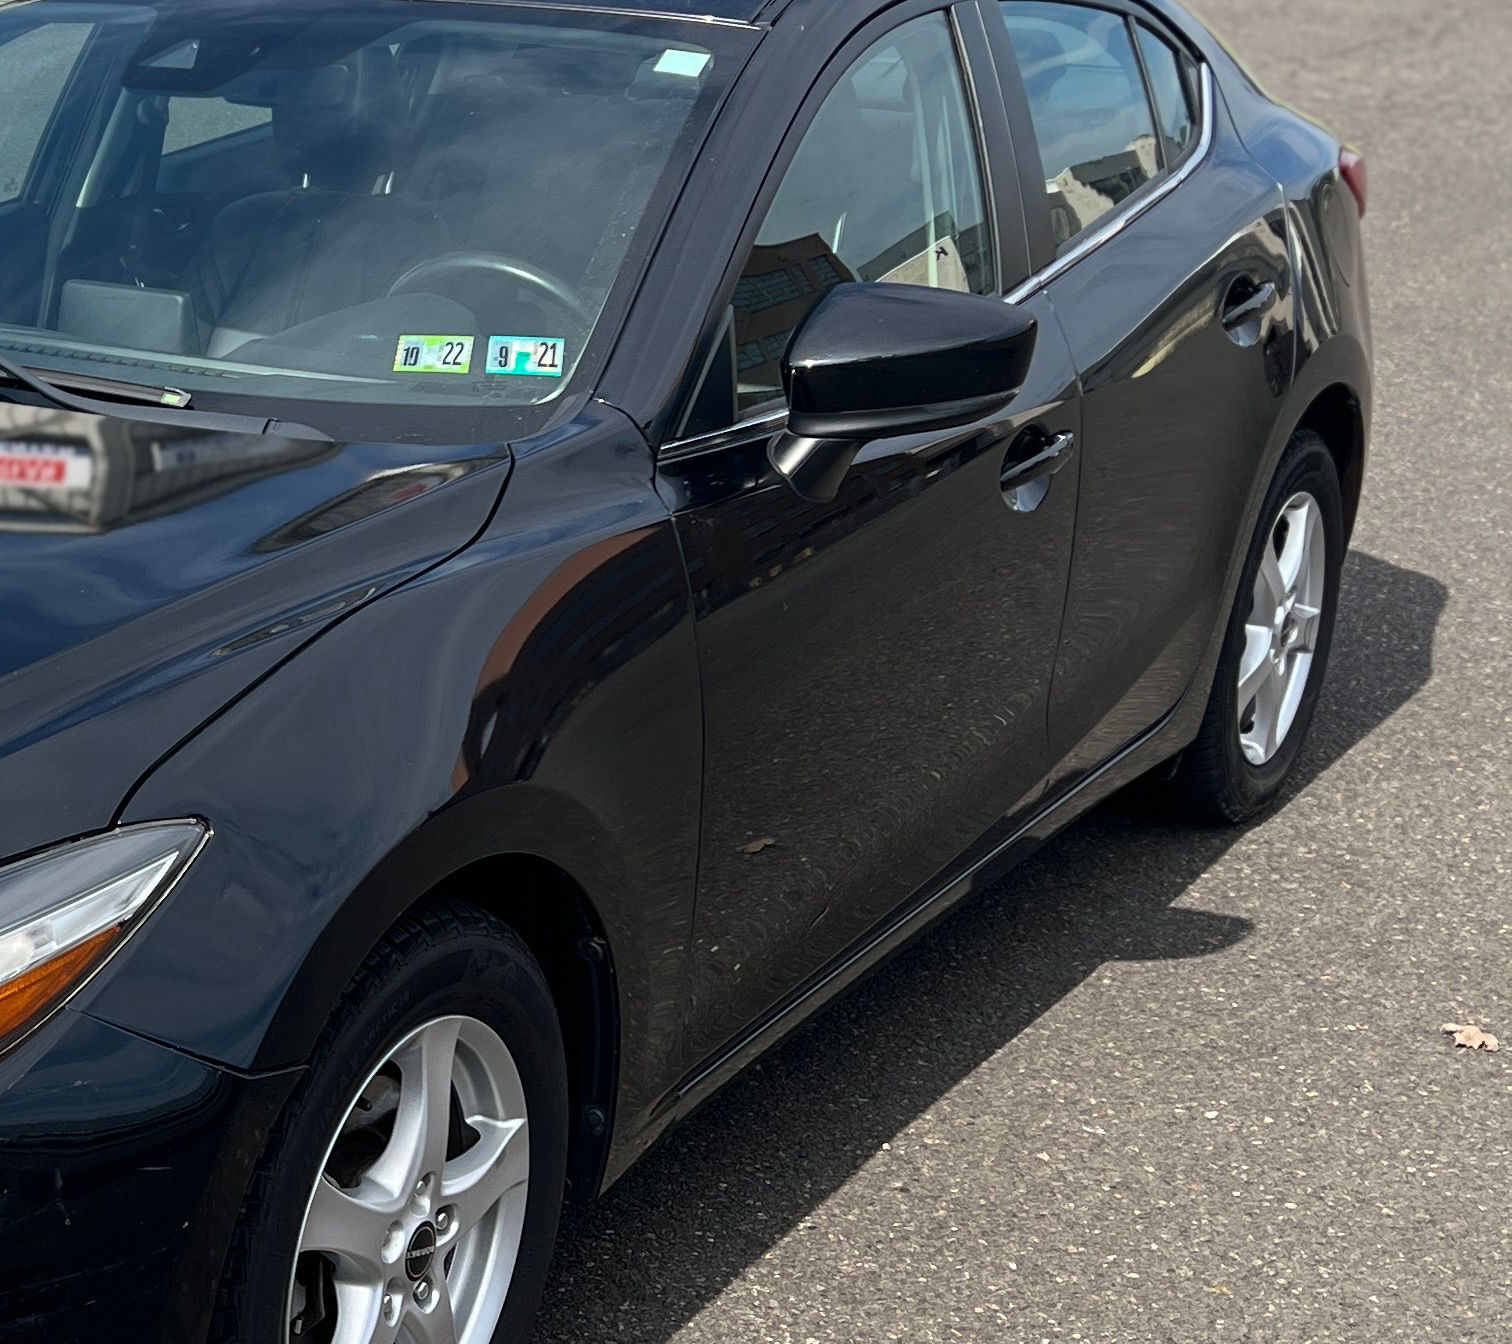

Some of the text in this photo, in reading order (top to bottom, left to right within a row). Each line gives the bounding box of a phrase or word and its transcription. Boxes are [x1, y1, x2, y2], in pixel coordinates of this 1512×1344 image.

[442, 342, 464, 365] 22
[498, 342, 558, 368] 9 21
